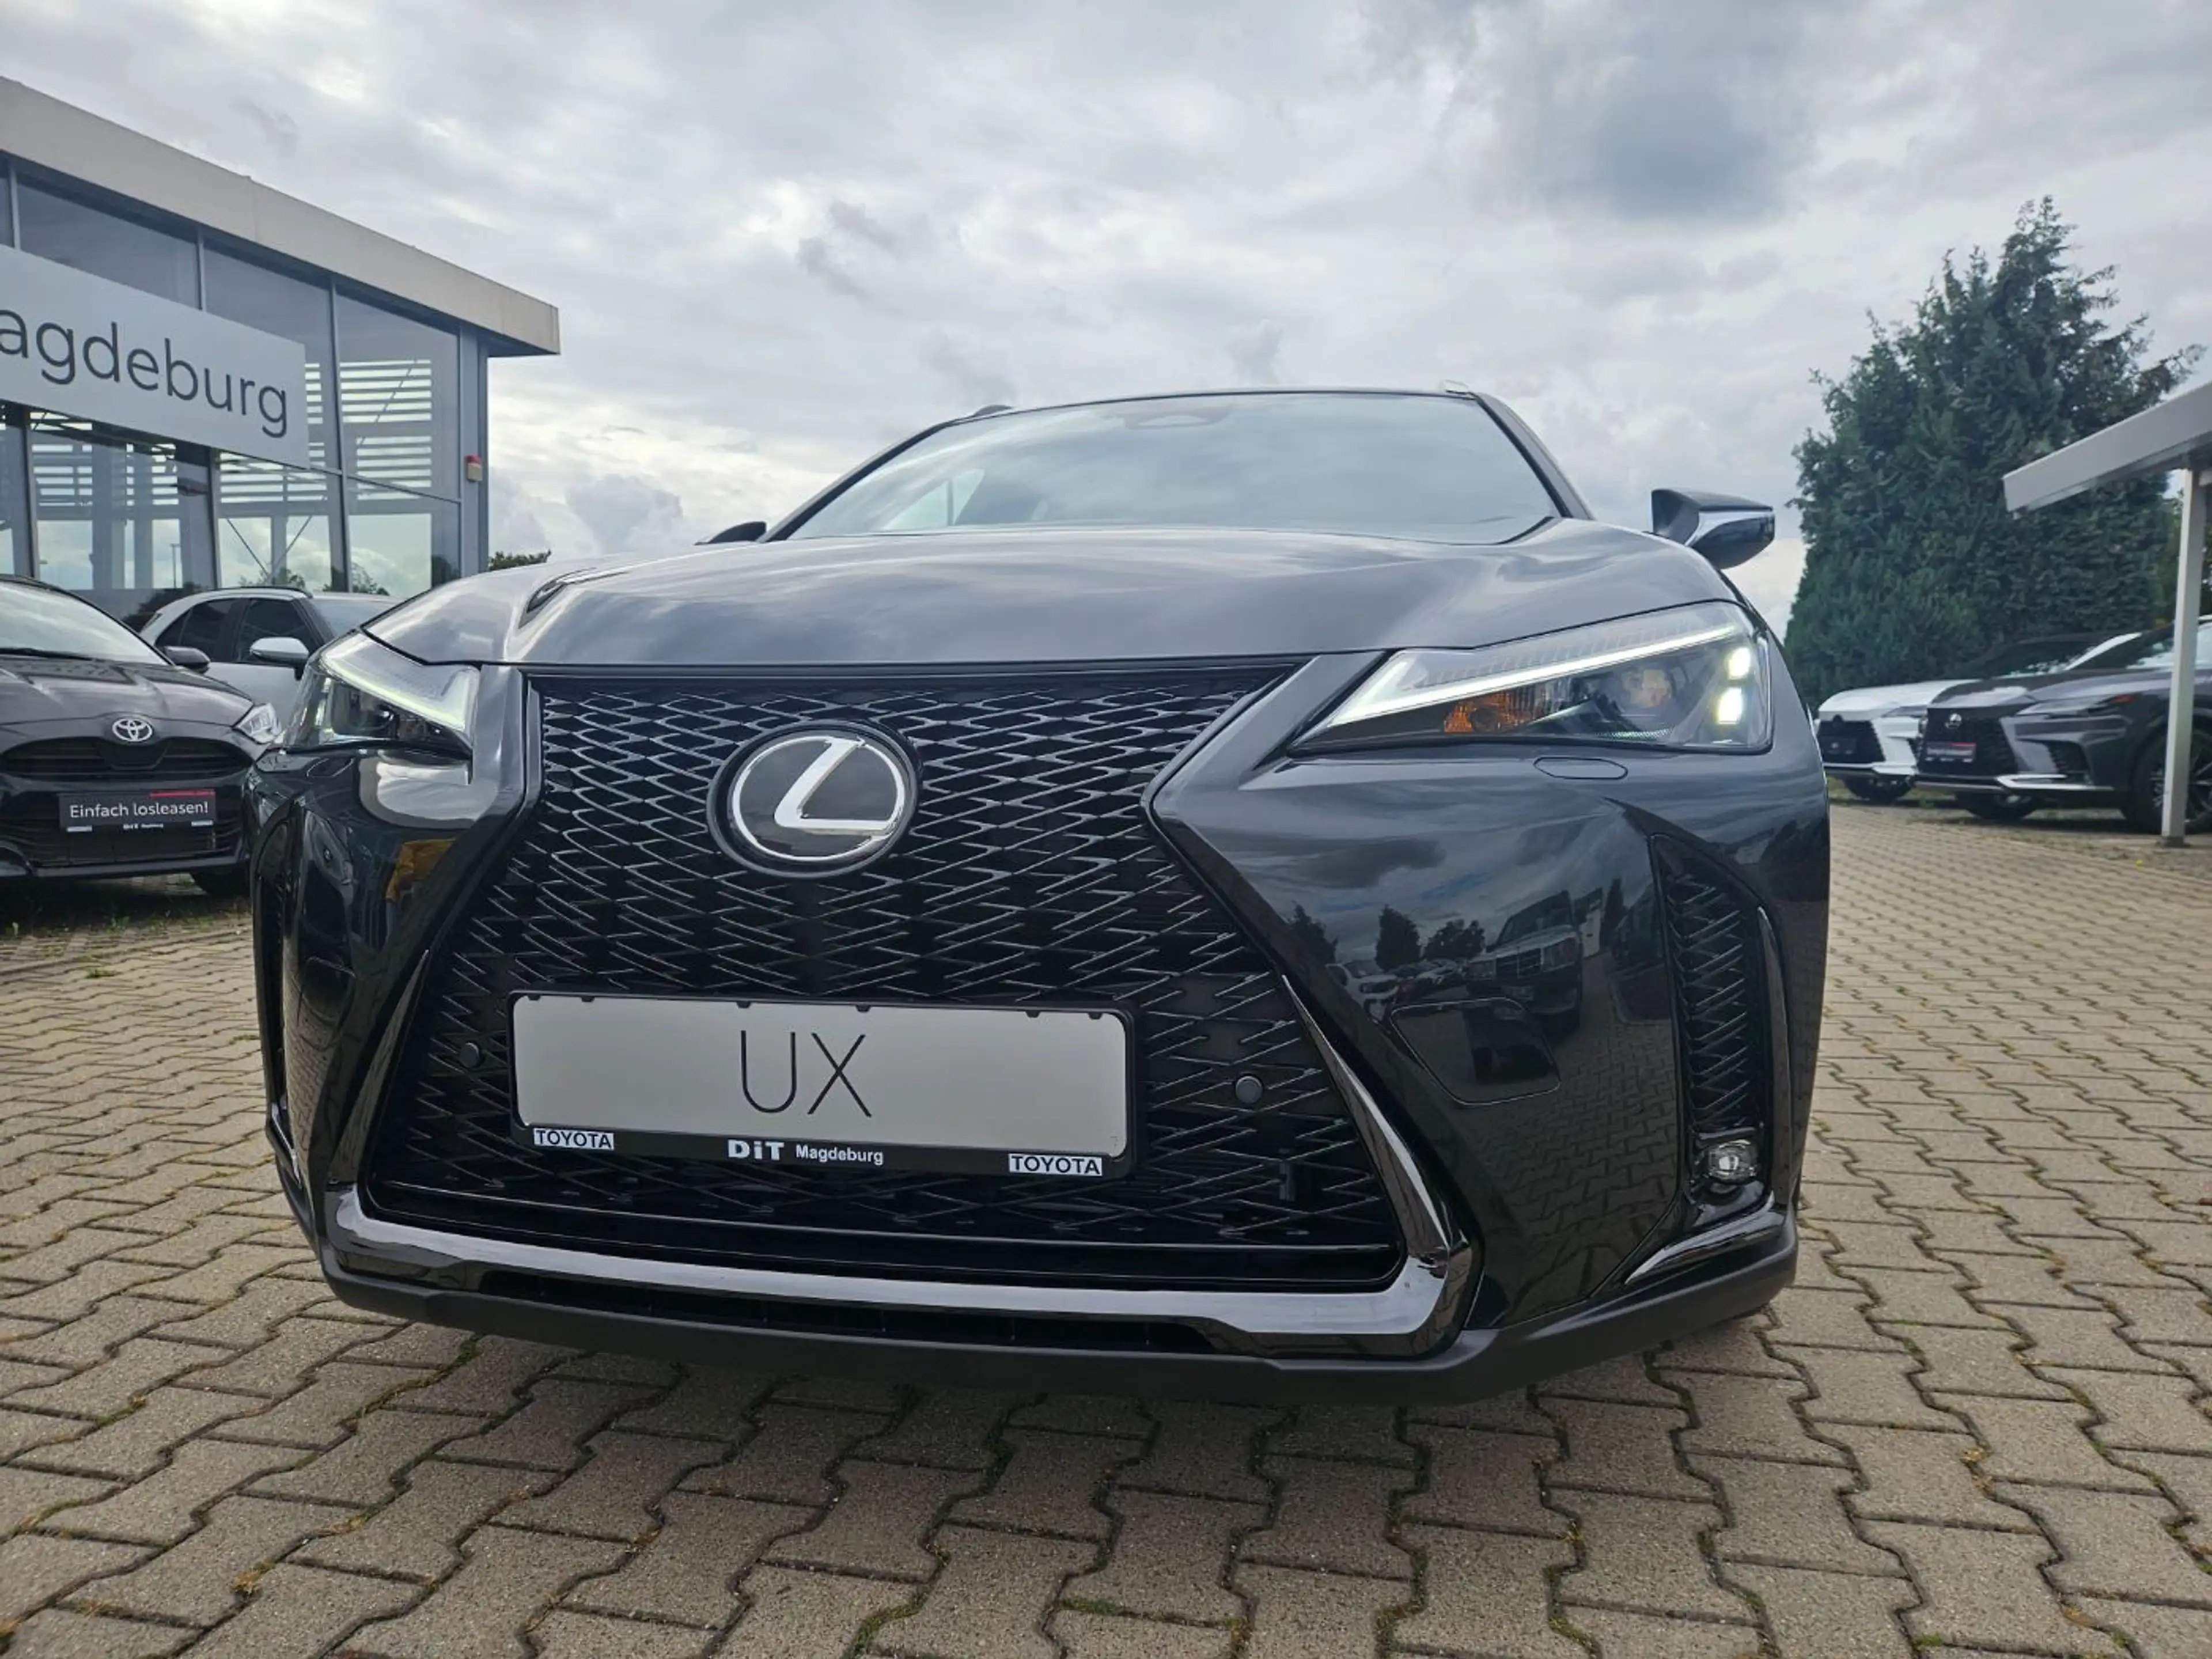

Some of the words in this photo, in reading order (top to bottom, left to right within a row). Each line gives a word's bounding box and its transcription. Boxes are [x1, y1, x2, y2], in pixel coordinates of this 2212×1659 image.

[0, 309, 288, 438] agdeburg
[69, 802, 129, 818] Einfach
[133, 801, 209, 816] losleasen!
[741, 1030, 872, 1118] UX
[535, 1129, 613, 1149] TOYOTA
[728, 1139, 785, 1160] DiT
[796, 1144, 884, 1165] Magdeburg
[1010, 1155, 1100, 1175] TOYOTA
